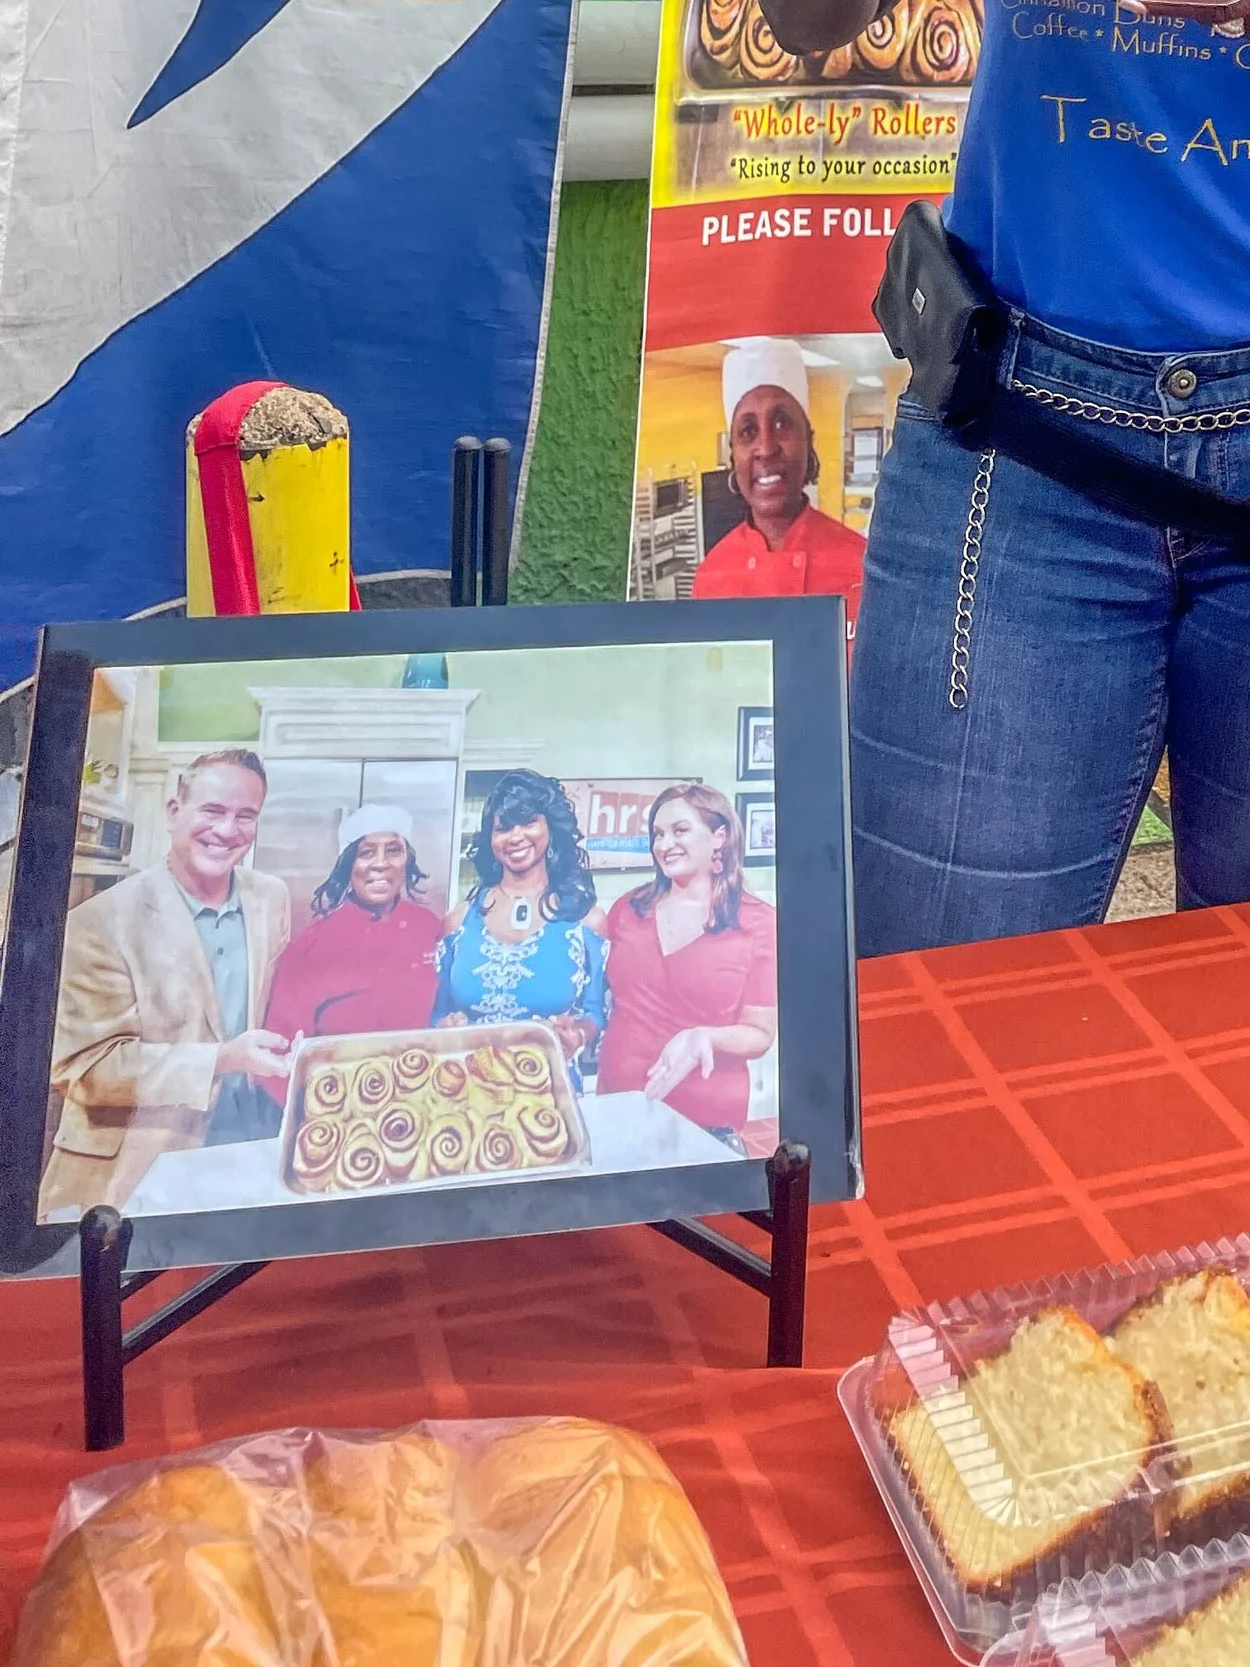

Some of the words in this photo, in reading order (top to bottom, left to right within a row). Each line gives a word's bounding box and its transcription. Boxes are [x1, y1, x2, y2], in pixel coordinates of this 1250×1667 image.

[1012, 11, 1088, 39] Coffee
[1112, 26, 1211, 60] Muffins
[872, 103, 956, 135] Rollers
[1039, 94, 1168, 154] Taste
[798, 155, 816, 175] to
[822, 160, 866, 182] your
[702, 207, 812, 246] PLEASE
[823, 207, 897, 237] FOLL
